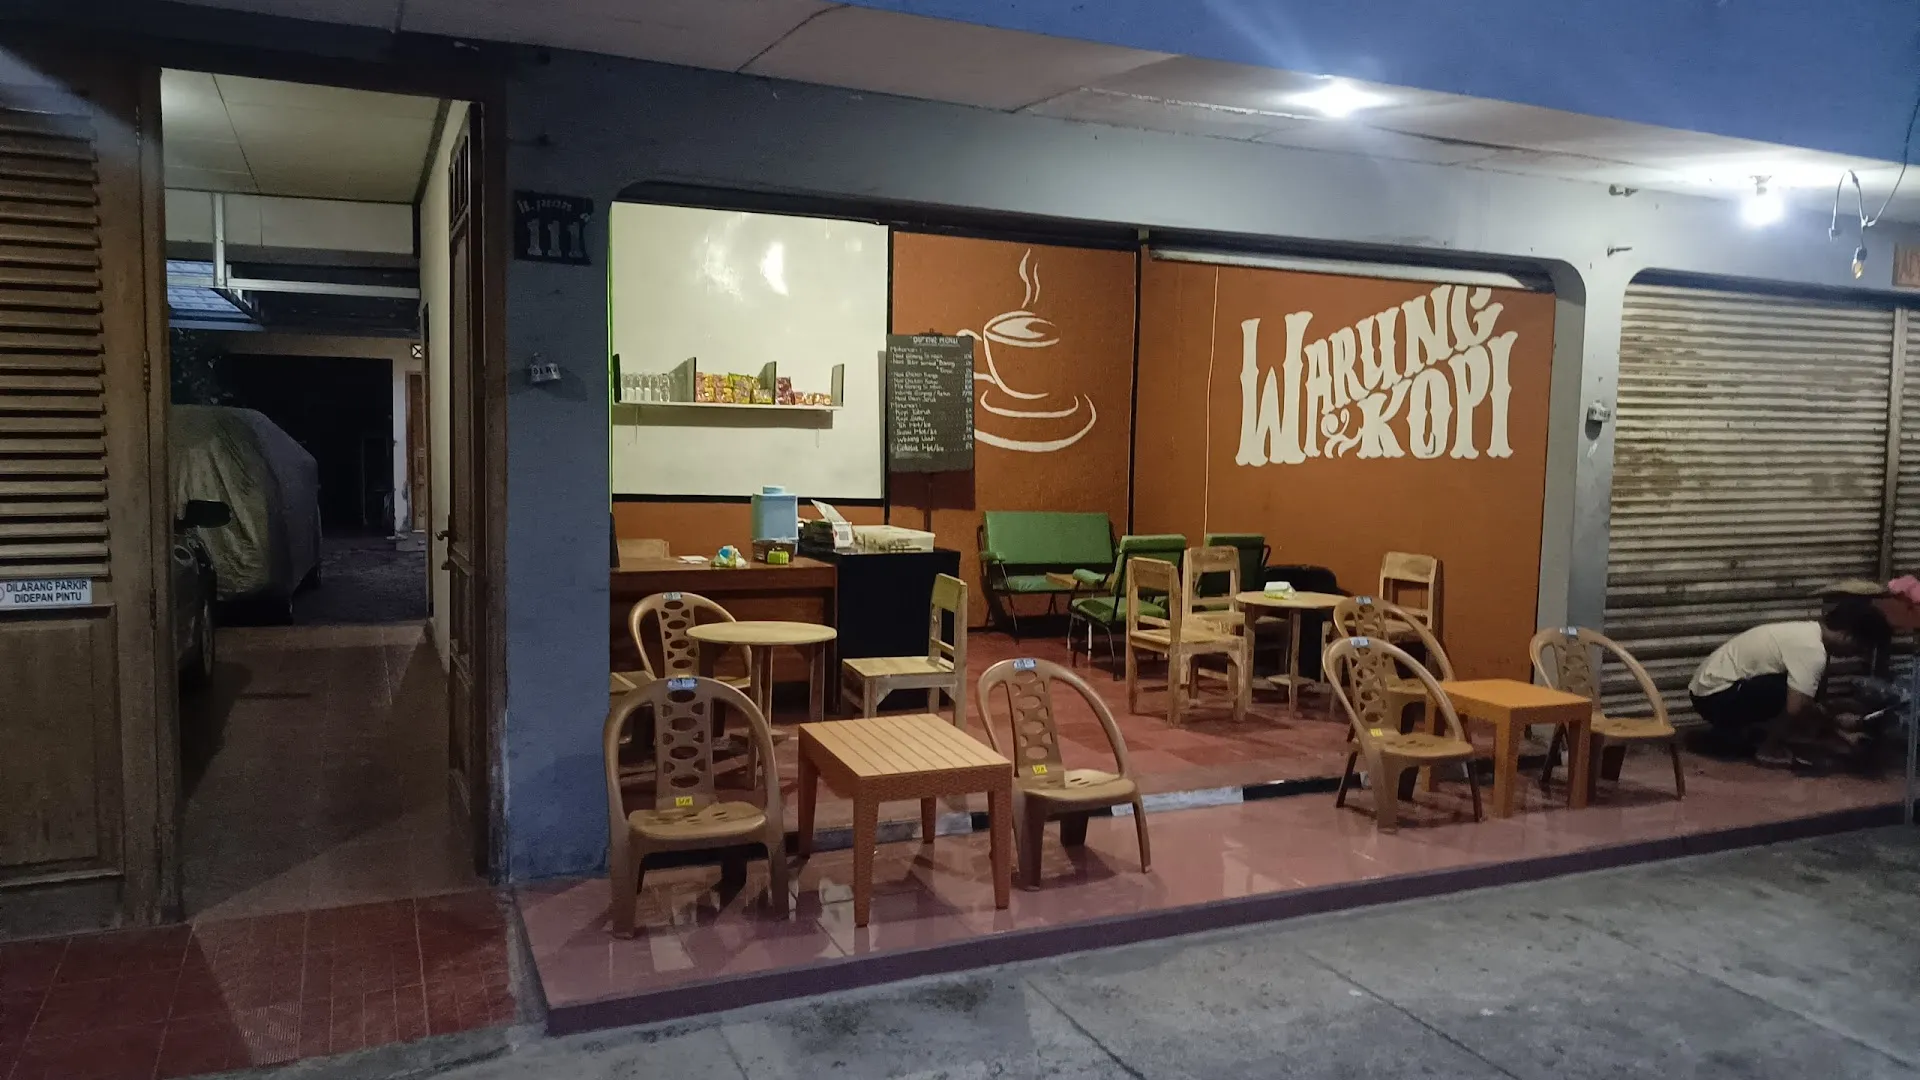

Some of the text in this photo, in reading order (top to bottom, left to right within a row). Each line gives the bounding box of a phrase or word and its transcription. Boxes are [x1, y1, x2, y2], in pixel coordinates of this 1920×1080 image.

[527, 218, 584, 258] 111
[1235, 284, 1504, 467] WARUNG
[1356, 330, 1519, 460] KOPI
[6, 580, 88, 593] DILARANG PARKIR
[14, 592, 82, 604] DIDEPAN PINTU
